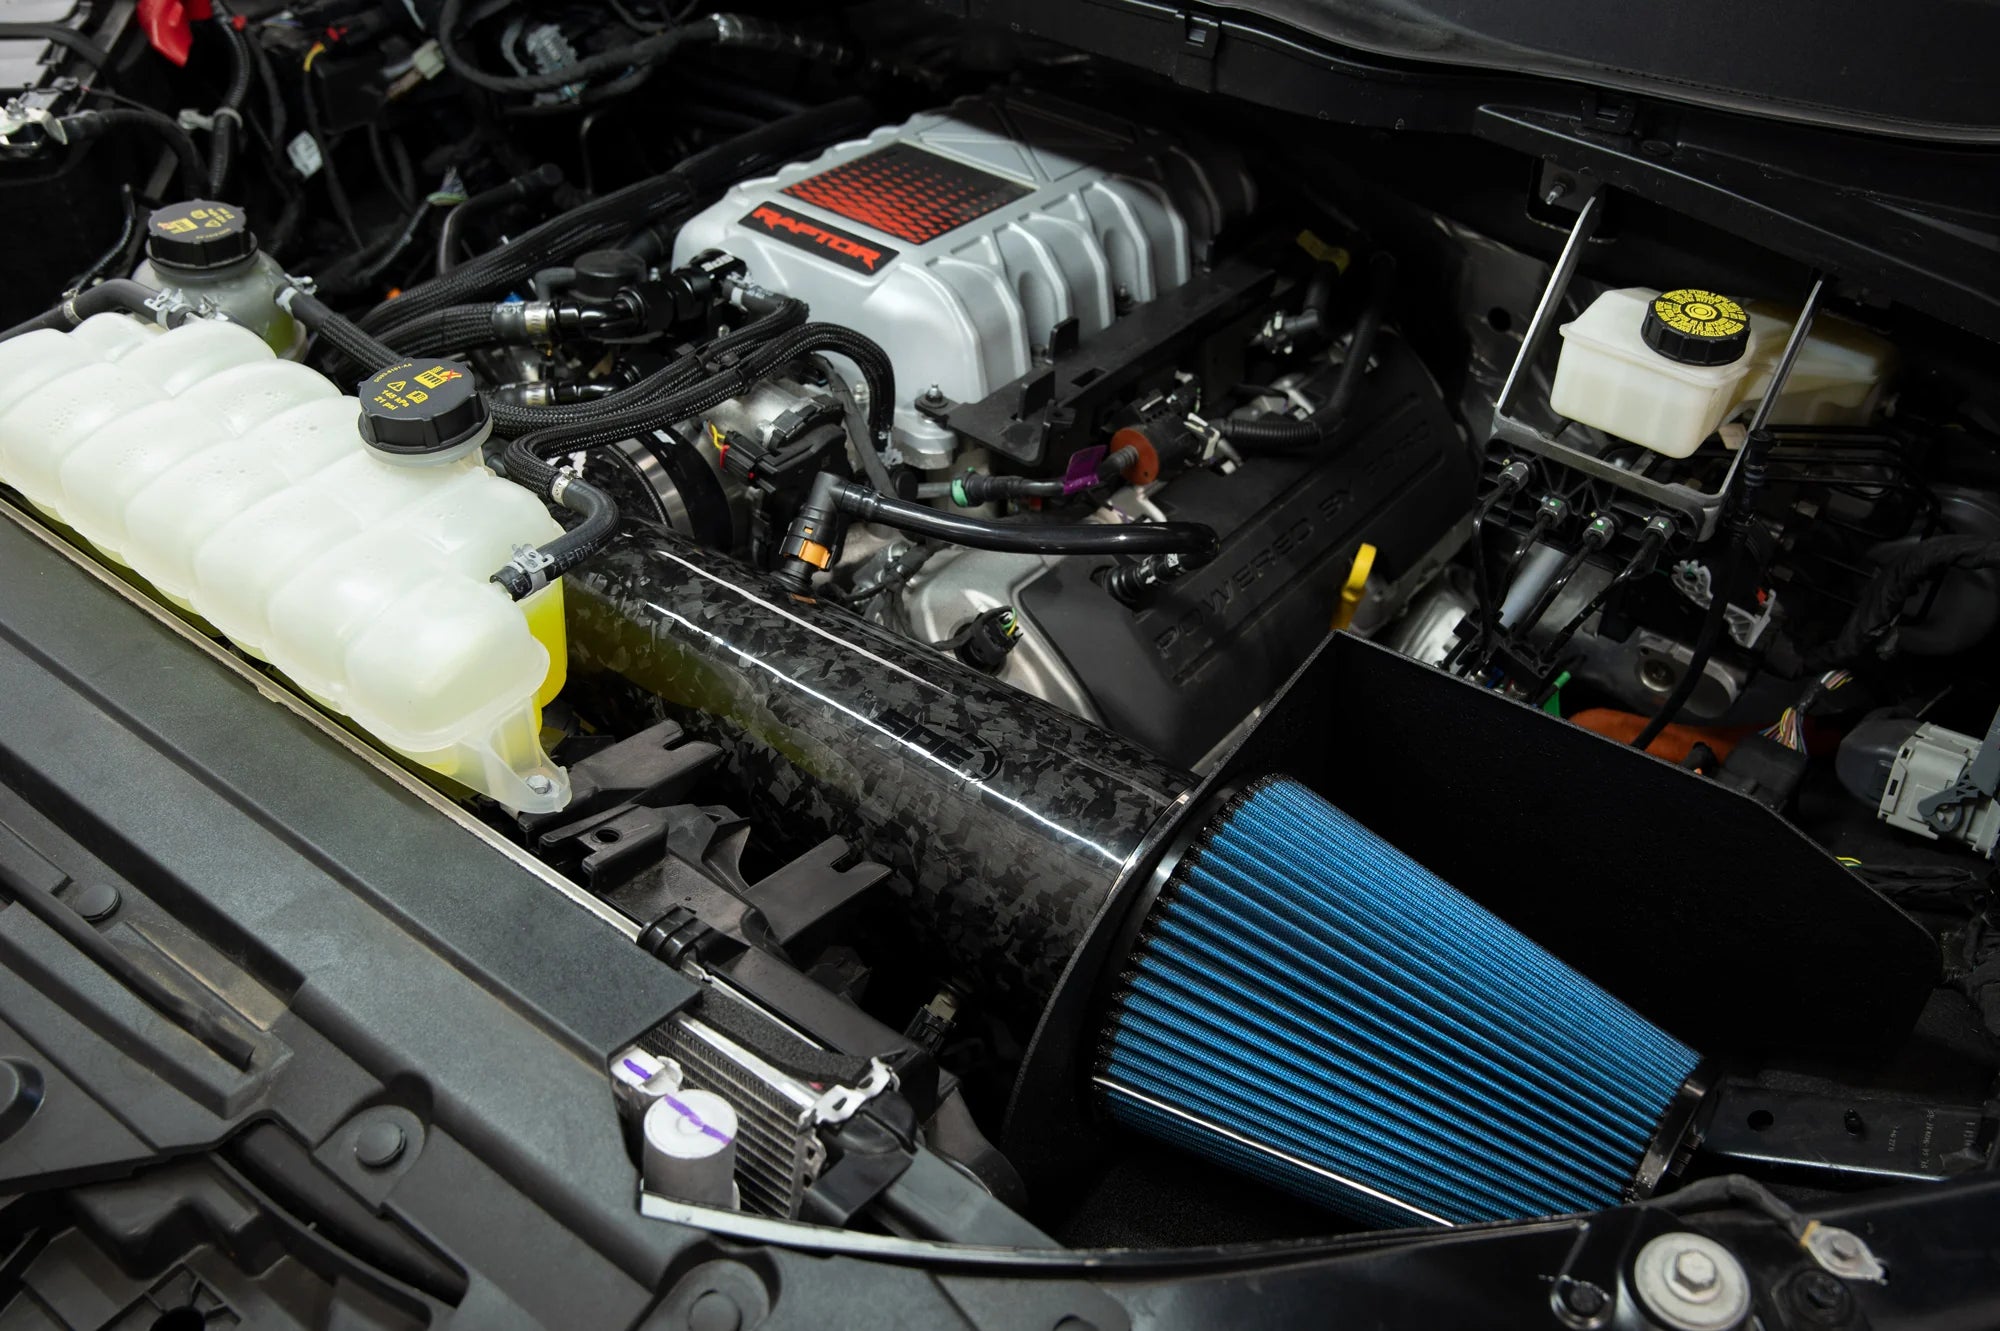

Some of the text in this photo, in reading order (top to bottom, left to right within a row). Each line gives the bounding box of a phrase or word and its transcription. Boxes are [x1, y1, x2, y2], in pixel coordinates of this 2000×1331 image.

[752, 207, 881, 270] RAPTOR
[373, 395, 399, 411] 21 psi
[381, 389, 410, 408] 145 kPa
[1153, 517, 1315, 659] POWERED
[1318, 478, 1355, 522] BY
